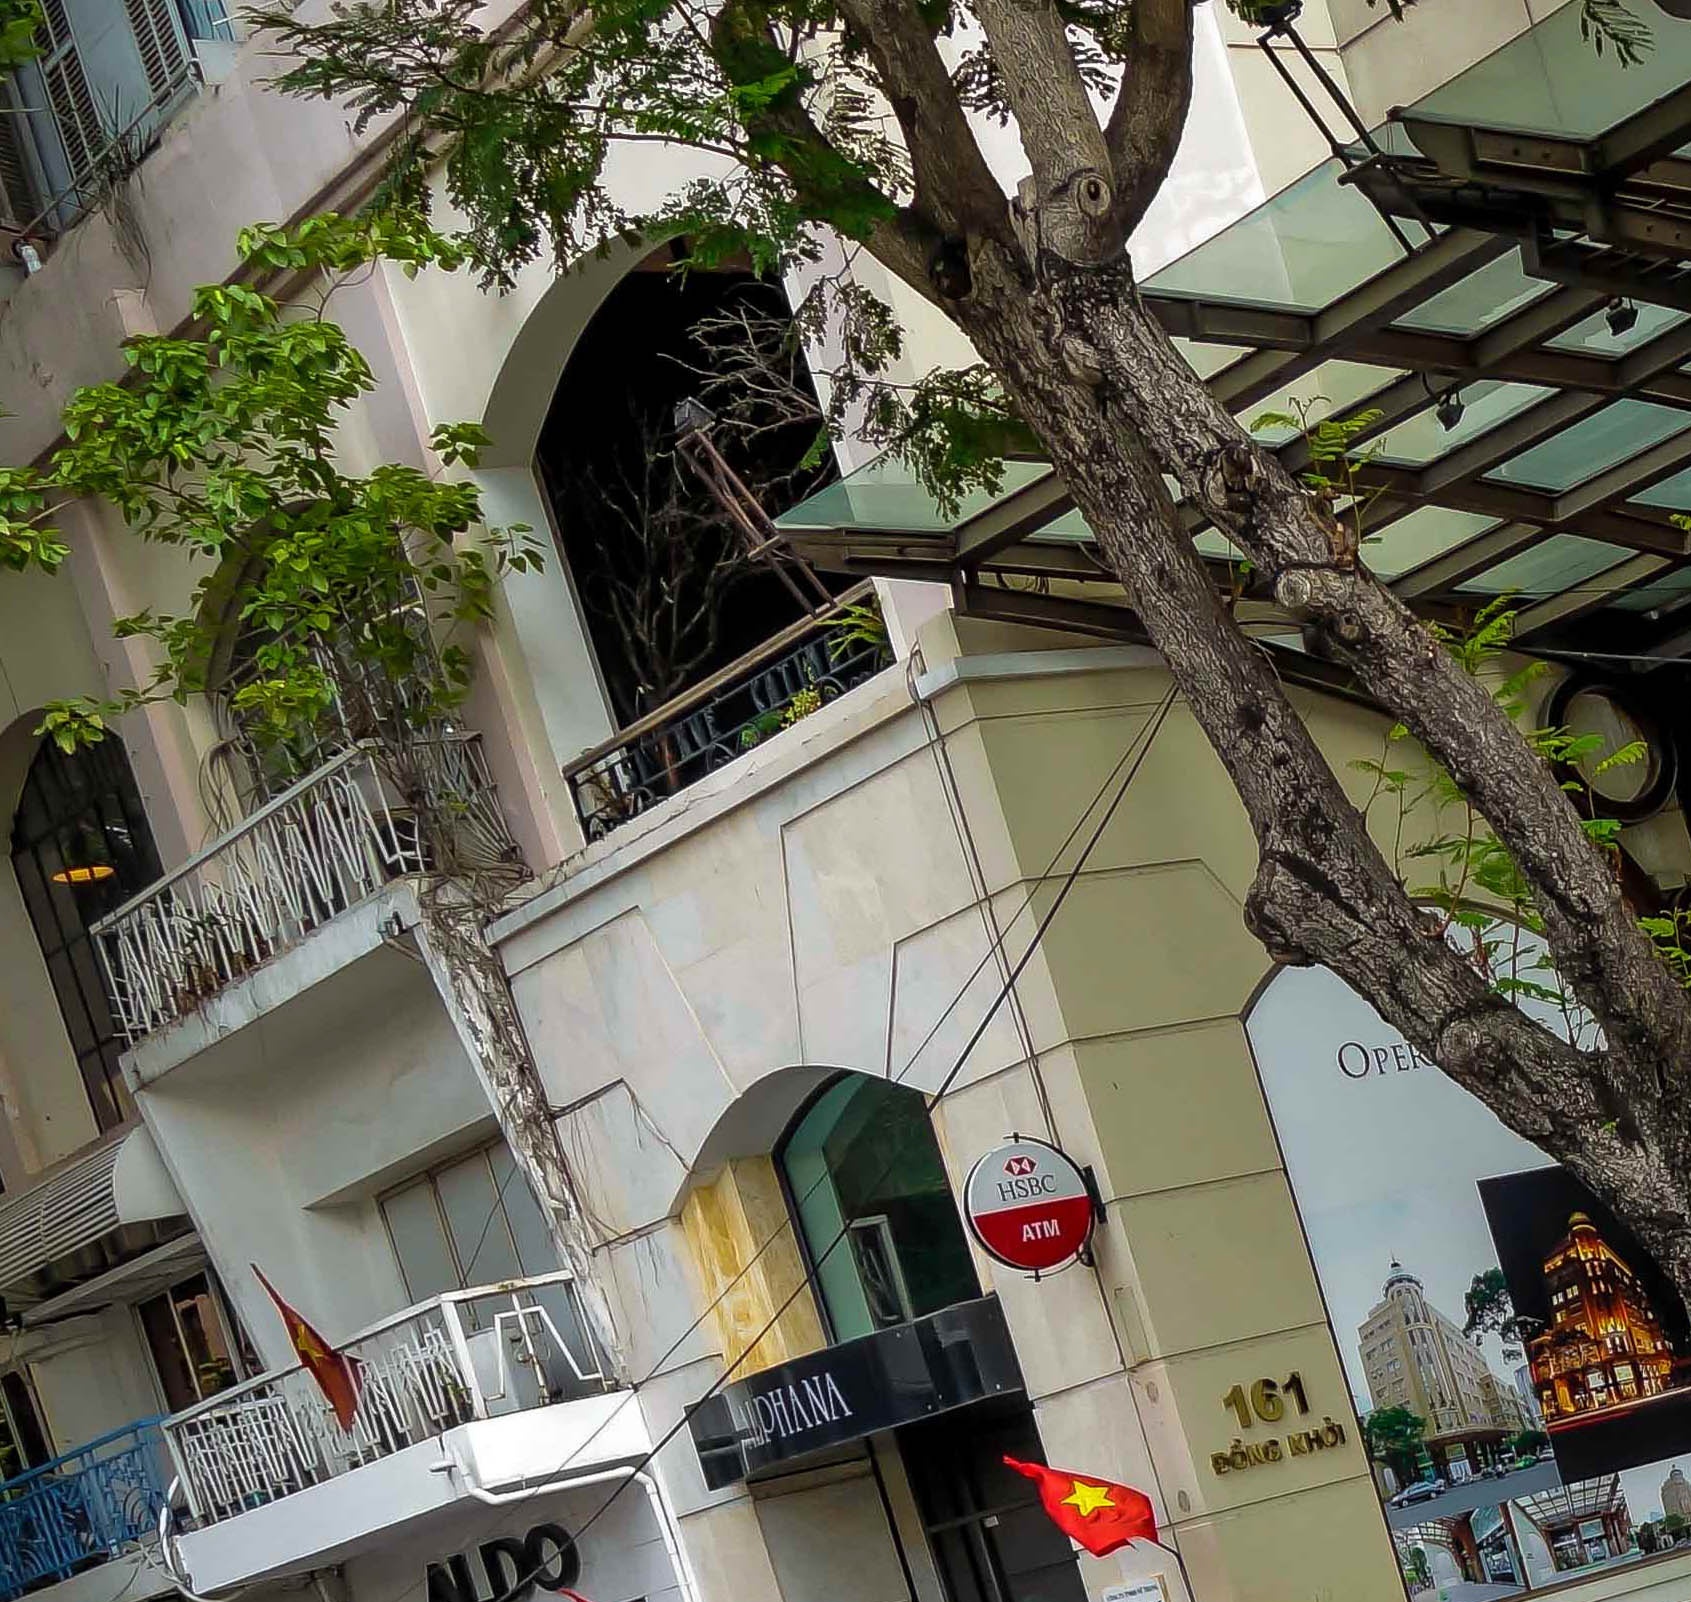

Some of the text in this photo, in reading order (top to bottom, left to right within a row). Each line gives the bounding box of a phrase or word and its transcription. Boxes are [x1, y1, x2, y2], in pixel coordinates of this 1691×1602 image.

[997, 1174, 1056, 1201] HSBC
[1023, 1219, 1060, 1242] ATM
[1222, 1370, 1310, 1429] 161
[1210, 1416, 1347, 1476] ĐỒNG KHỞI
